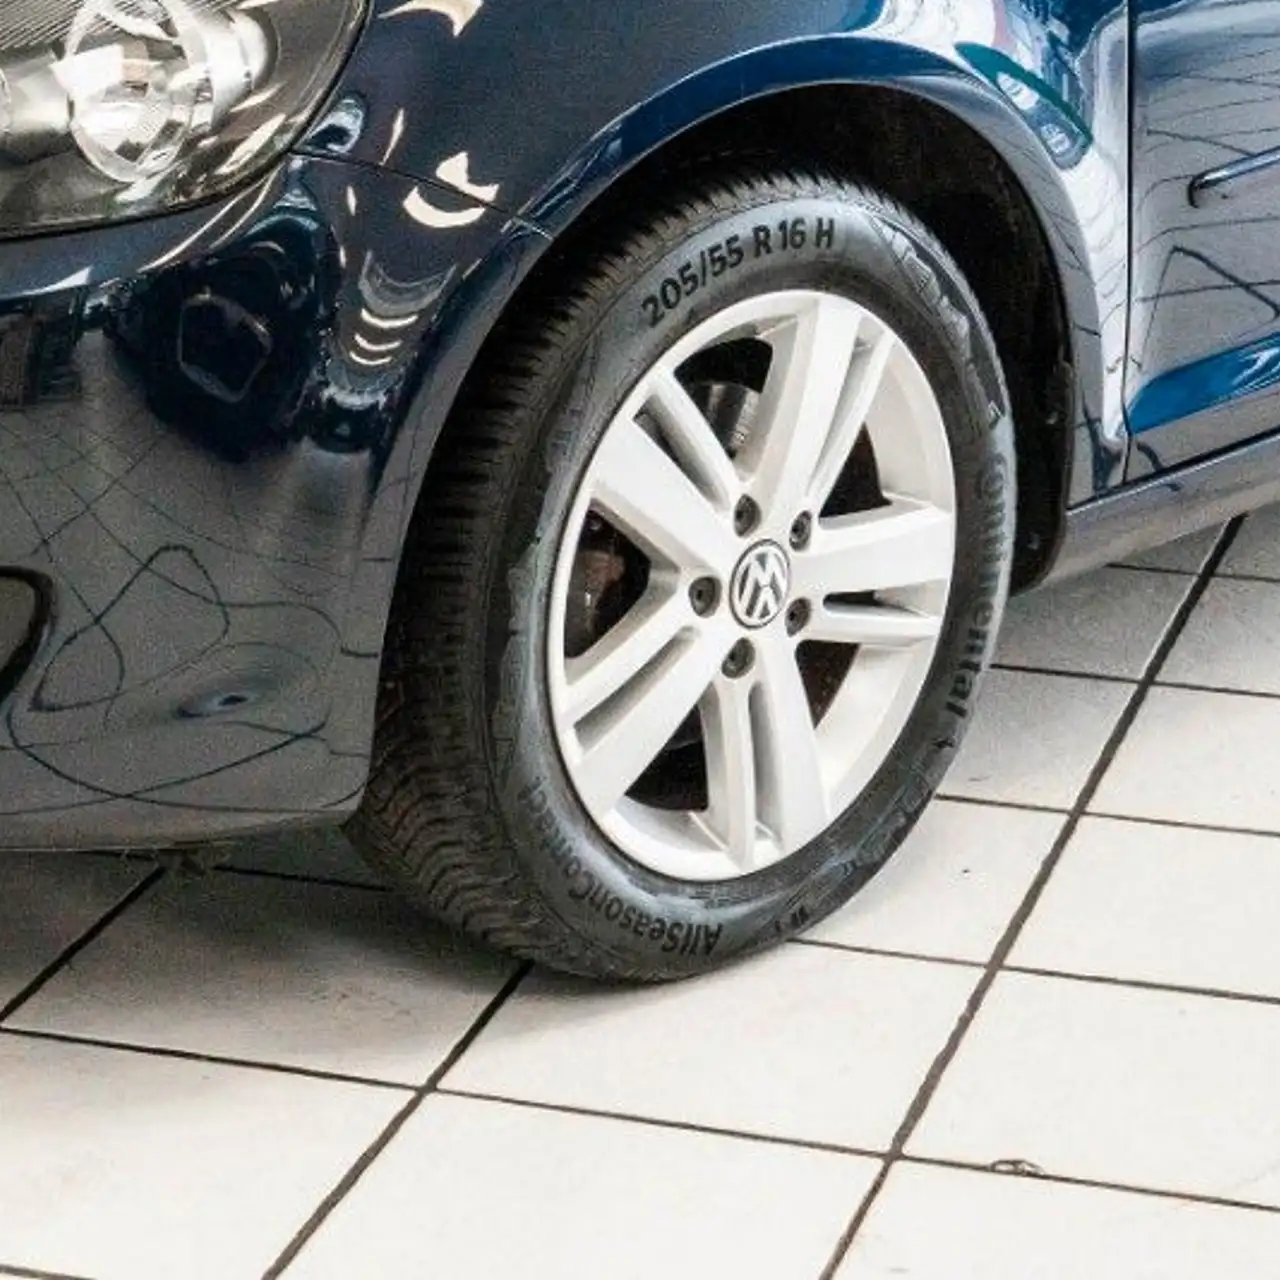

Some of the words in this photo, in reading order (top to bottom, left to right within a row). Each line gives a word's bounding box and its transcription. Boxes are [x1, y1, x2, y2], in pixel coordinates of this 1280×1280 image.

[640, 233, 745, 329] 205/55
[752, 223, 773, 259] R
[778, 216, 806, 252] 16
[814, 216, 835, 250] H
